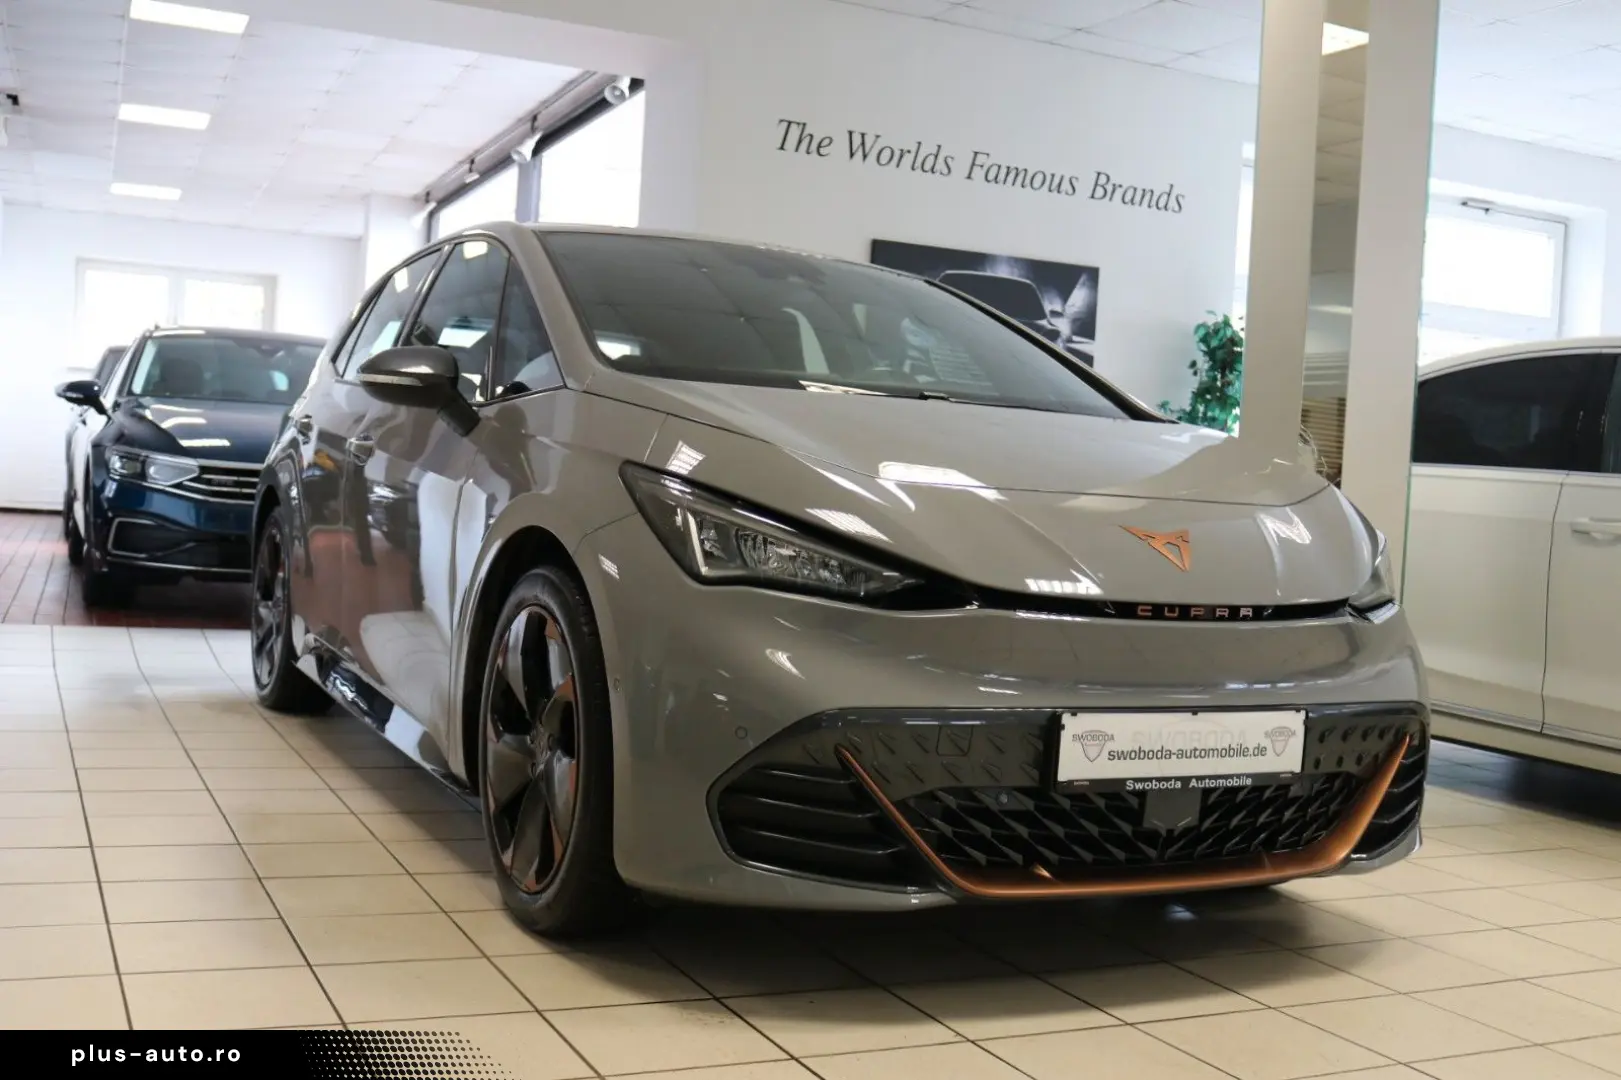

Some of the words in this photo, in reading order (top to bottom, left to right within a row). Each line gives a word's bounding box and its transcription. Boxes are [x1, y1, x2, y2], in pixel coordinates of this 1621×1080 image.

[776, 118, 834, 157] The
[846, 129, 955, 177] Worlds
[964, 150, 1080, 197] Famous
[1087, 171, 1187, 214] Brands
[1137, 605, 1253, 618] CUPRA
[1072, 733, 1115, 742] SWOBODA
[1107, 743, 1268, 762] swoboda-automobile.de
[1125, 779, 1182, 791] Swoboda
[1189, 775, 1253, 789] Automobile
